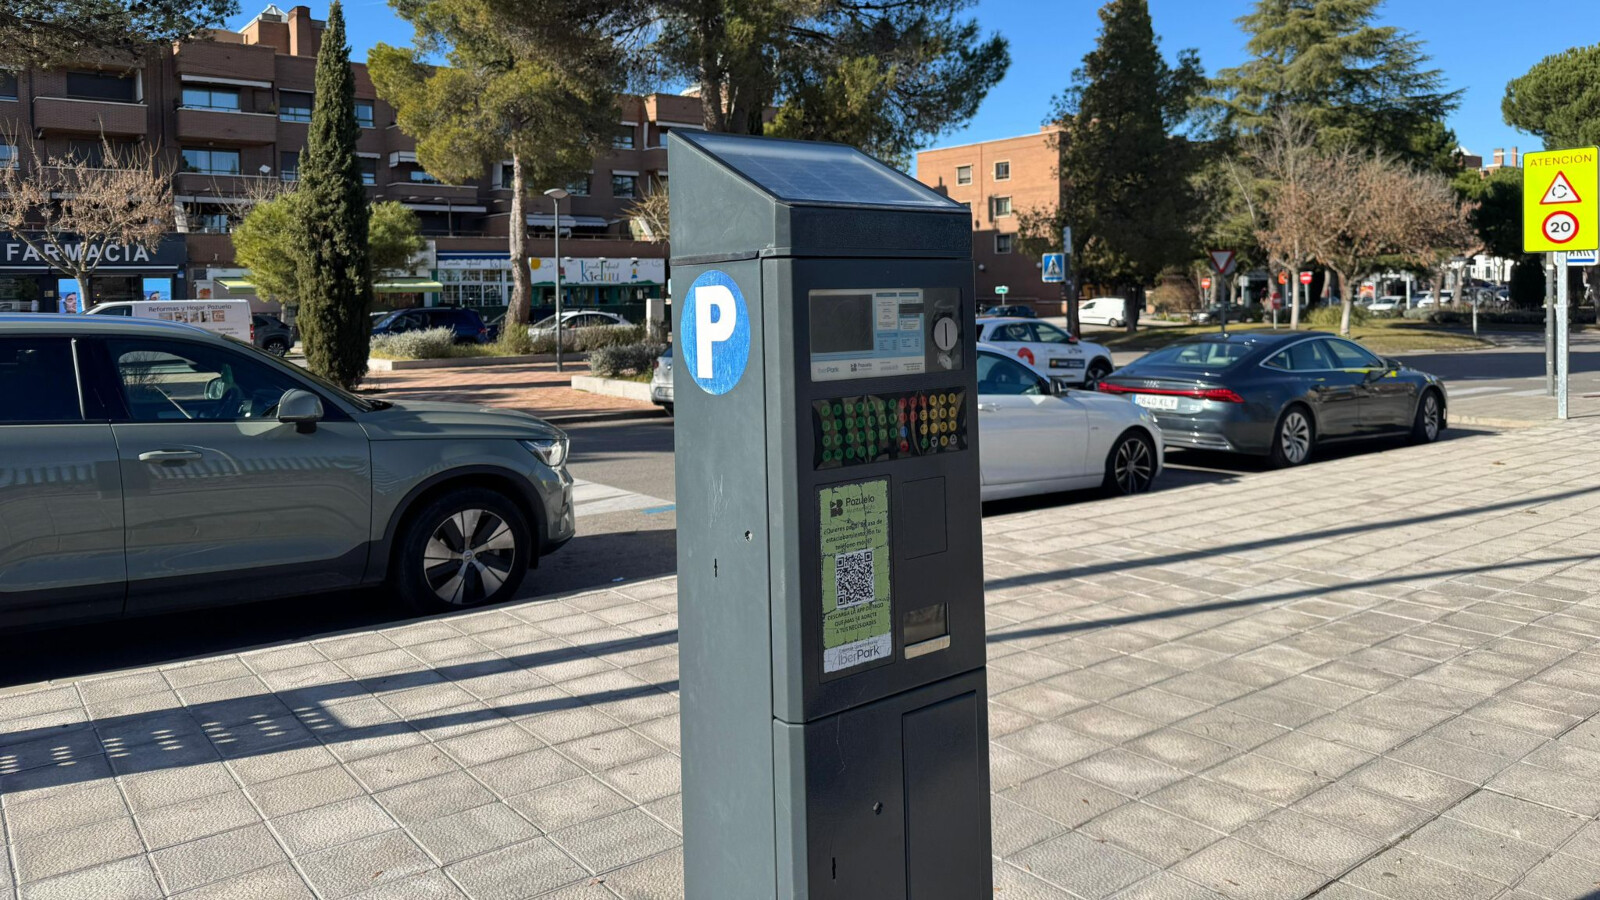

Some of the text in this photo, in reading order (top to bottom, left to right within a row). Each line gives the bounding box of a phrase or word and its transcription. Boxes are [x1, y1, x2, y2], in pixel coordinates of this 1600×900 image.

[1530, 152, 1592, 167] ATENCIÓN
[1551, 222, 1571, 233] 20
[6, 243, 150, 262] FARMACIA
[694, 285, 737, 379] P
